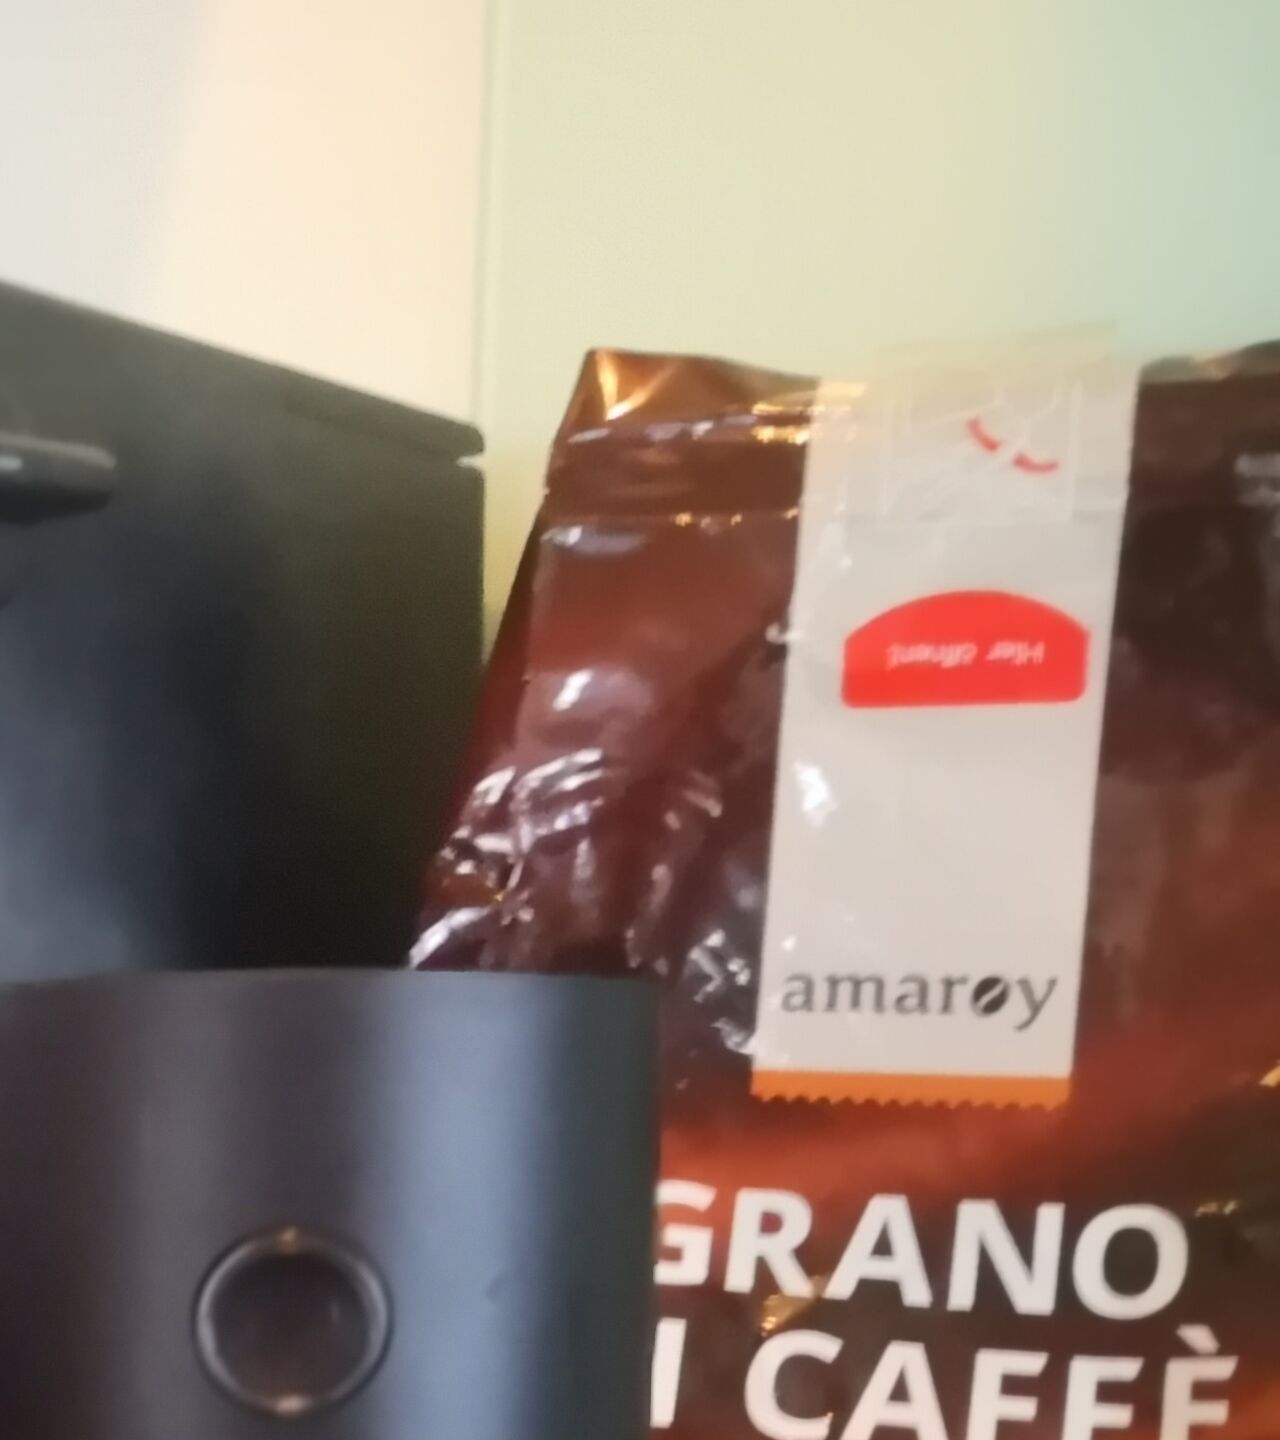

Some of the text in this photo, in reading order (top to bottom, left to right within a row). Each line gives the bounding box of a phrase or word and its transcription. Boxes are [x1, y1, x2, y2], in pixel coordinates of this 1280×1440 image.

[780, 972, 1058, 1032] amaroy
[653, 1180, 1189, 1321] GRANO
[651, 1318, 687, 1428] I
